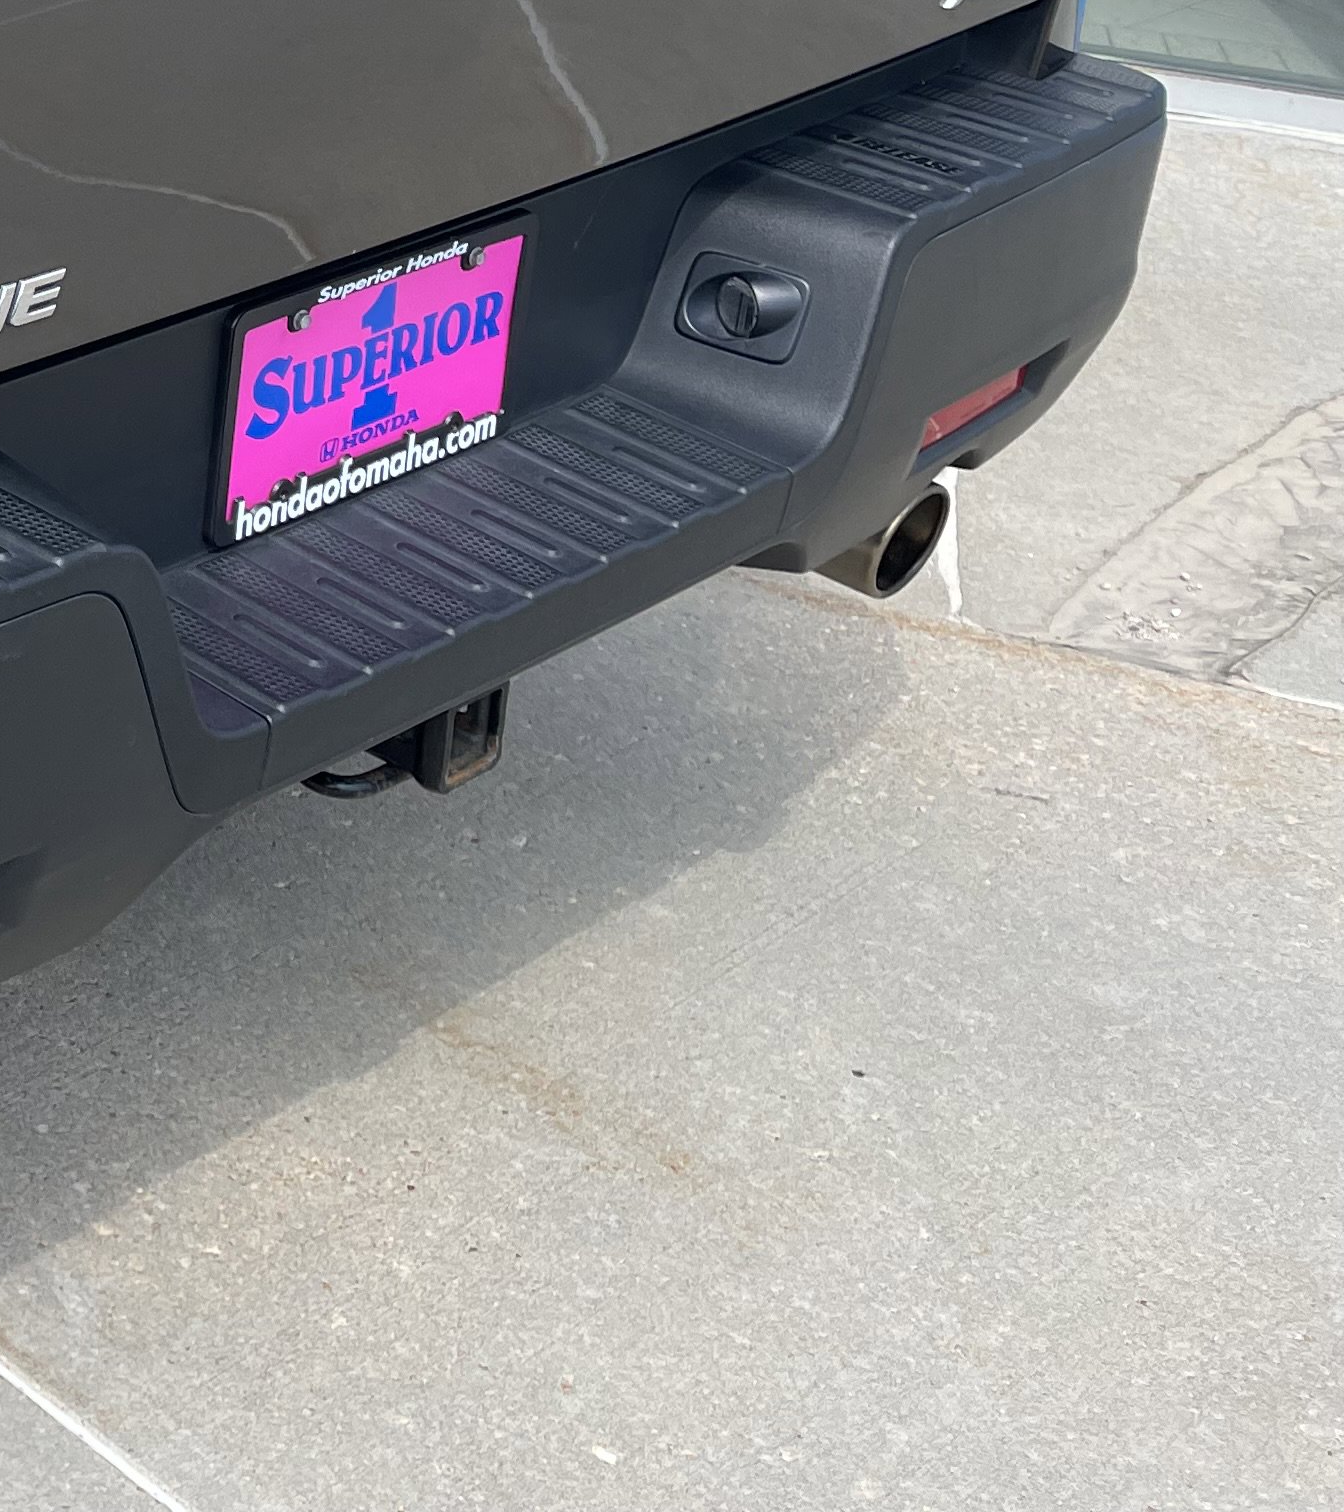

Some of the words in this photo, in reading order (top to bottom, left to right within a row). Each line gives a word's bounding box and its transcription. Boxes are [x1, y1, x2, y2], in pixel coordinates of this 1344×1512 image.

[317, 264, 403, 303] Superior
[405, 240, 470, 274] Honda
[245, 291, 504, 441] SUPERIOR
[235, 412, 498, 541] hondaofomaha.com
[340, 408, 420, 452] HONDA
